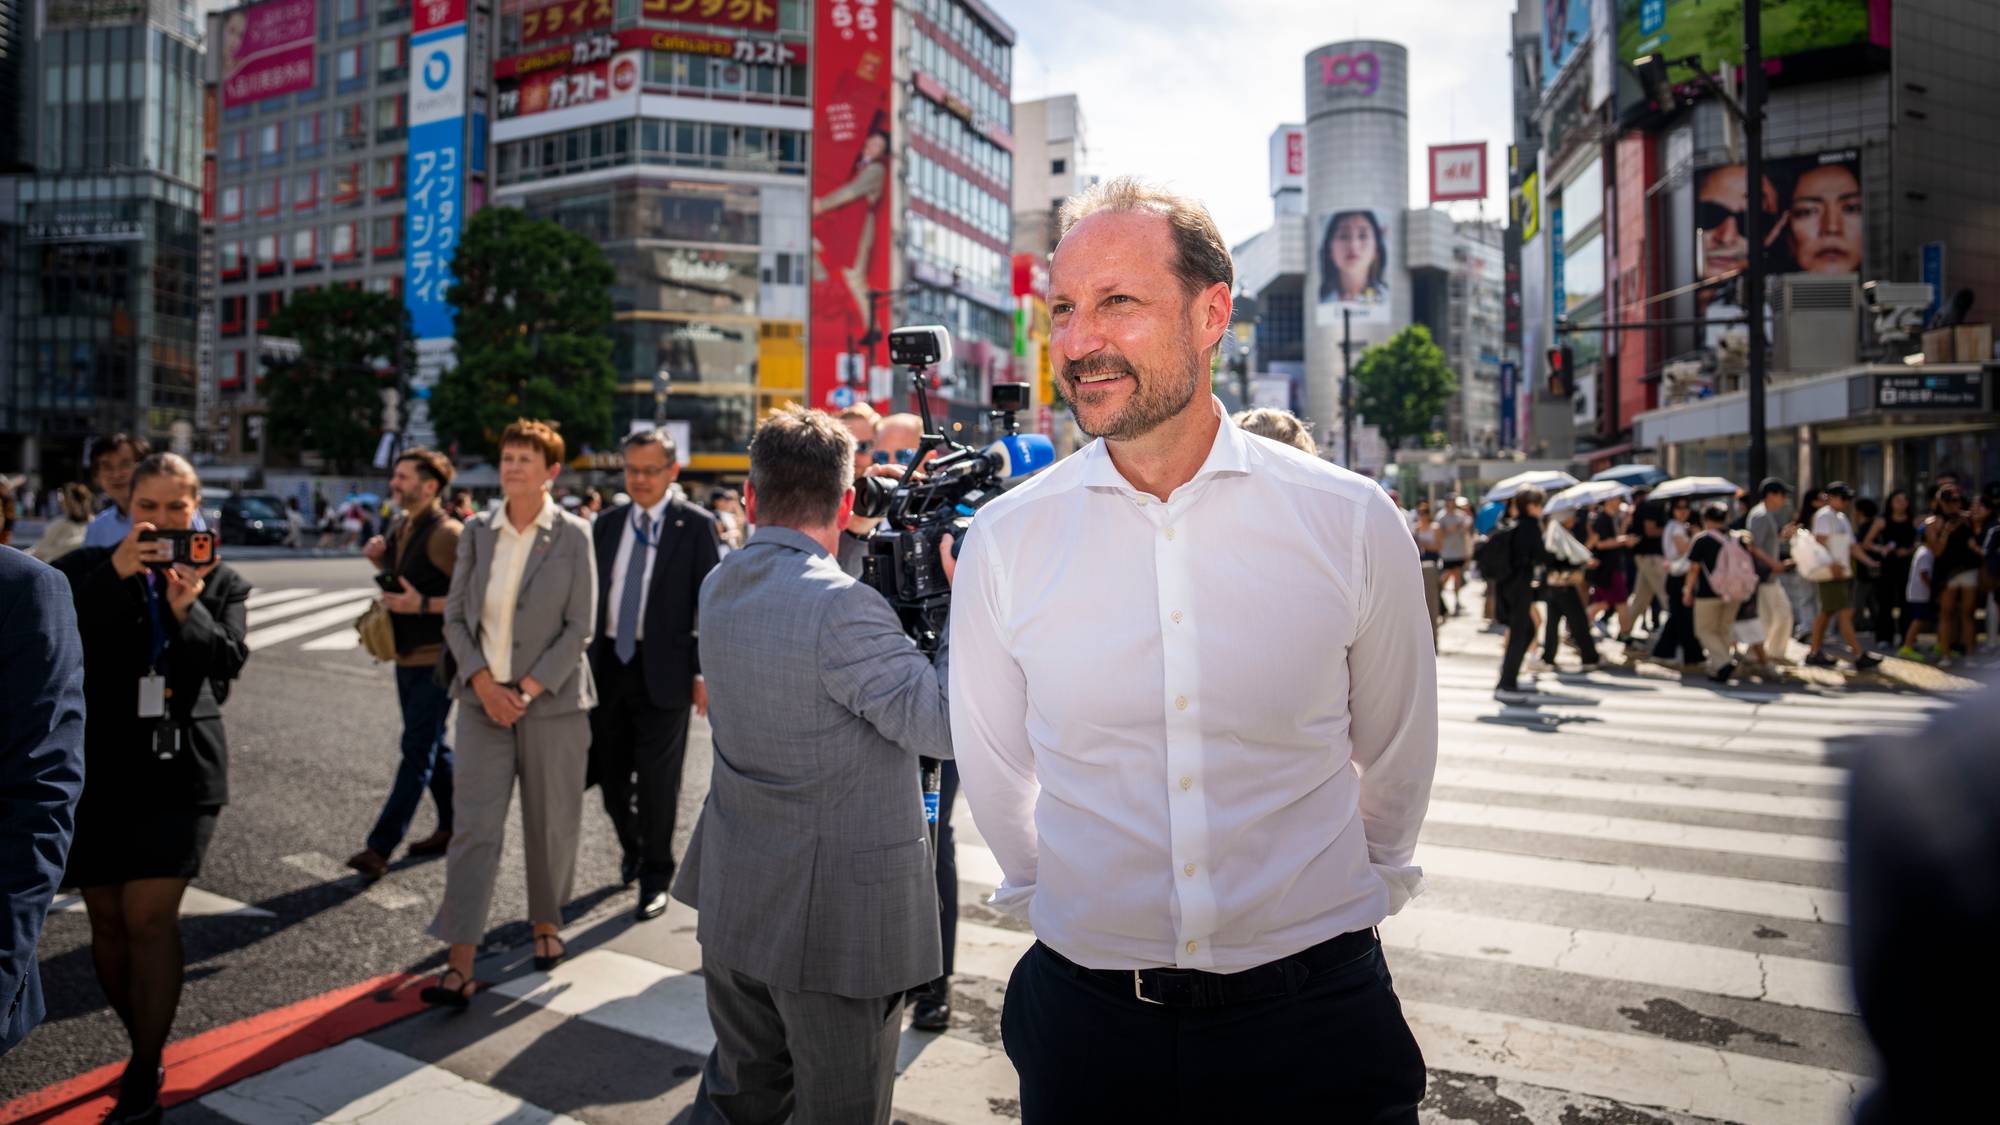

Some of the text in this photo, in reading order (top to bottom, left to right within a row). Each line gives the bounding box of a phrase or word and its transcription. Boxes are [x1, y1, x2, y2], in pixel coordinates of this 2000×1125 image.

[1319, 51, 1380, 96] 109
[413, 150, 436, 304] アイシティ
